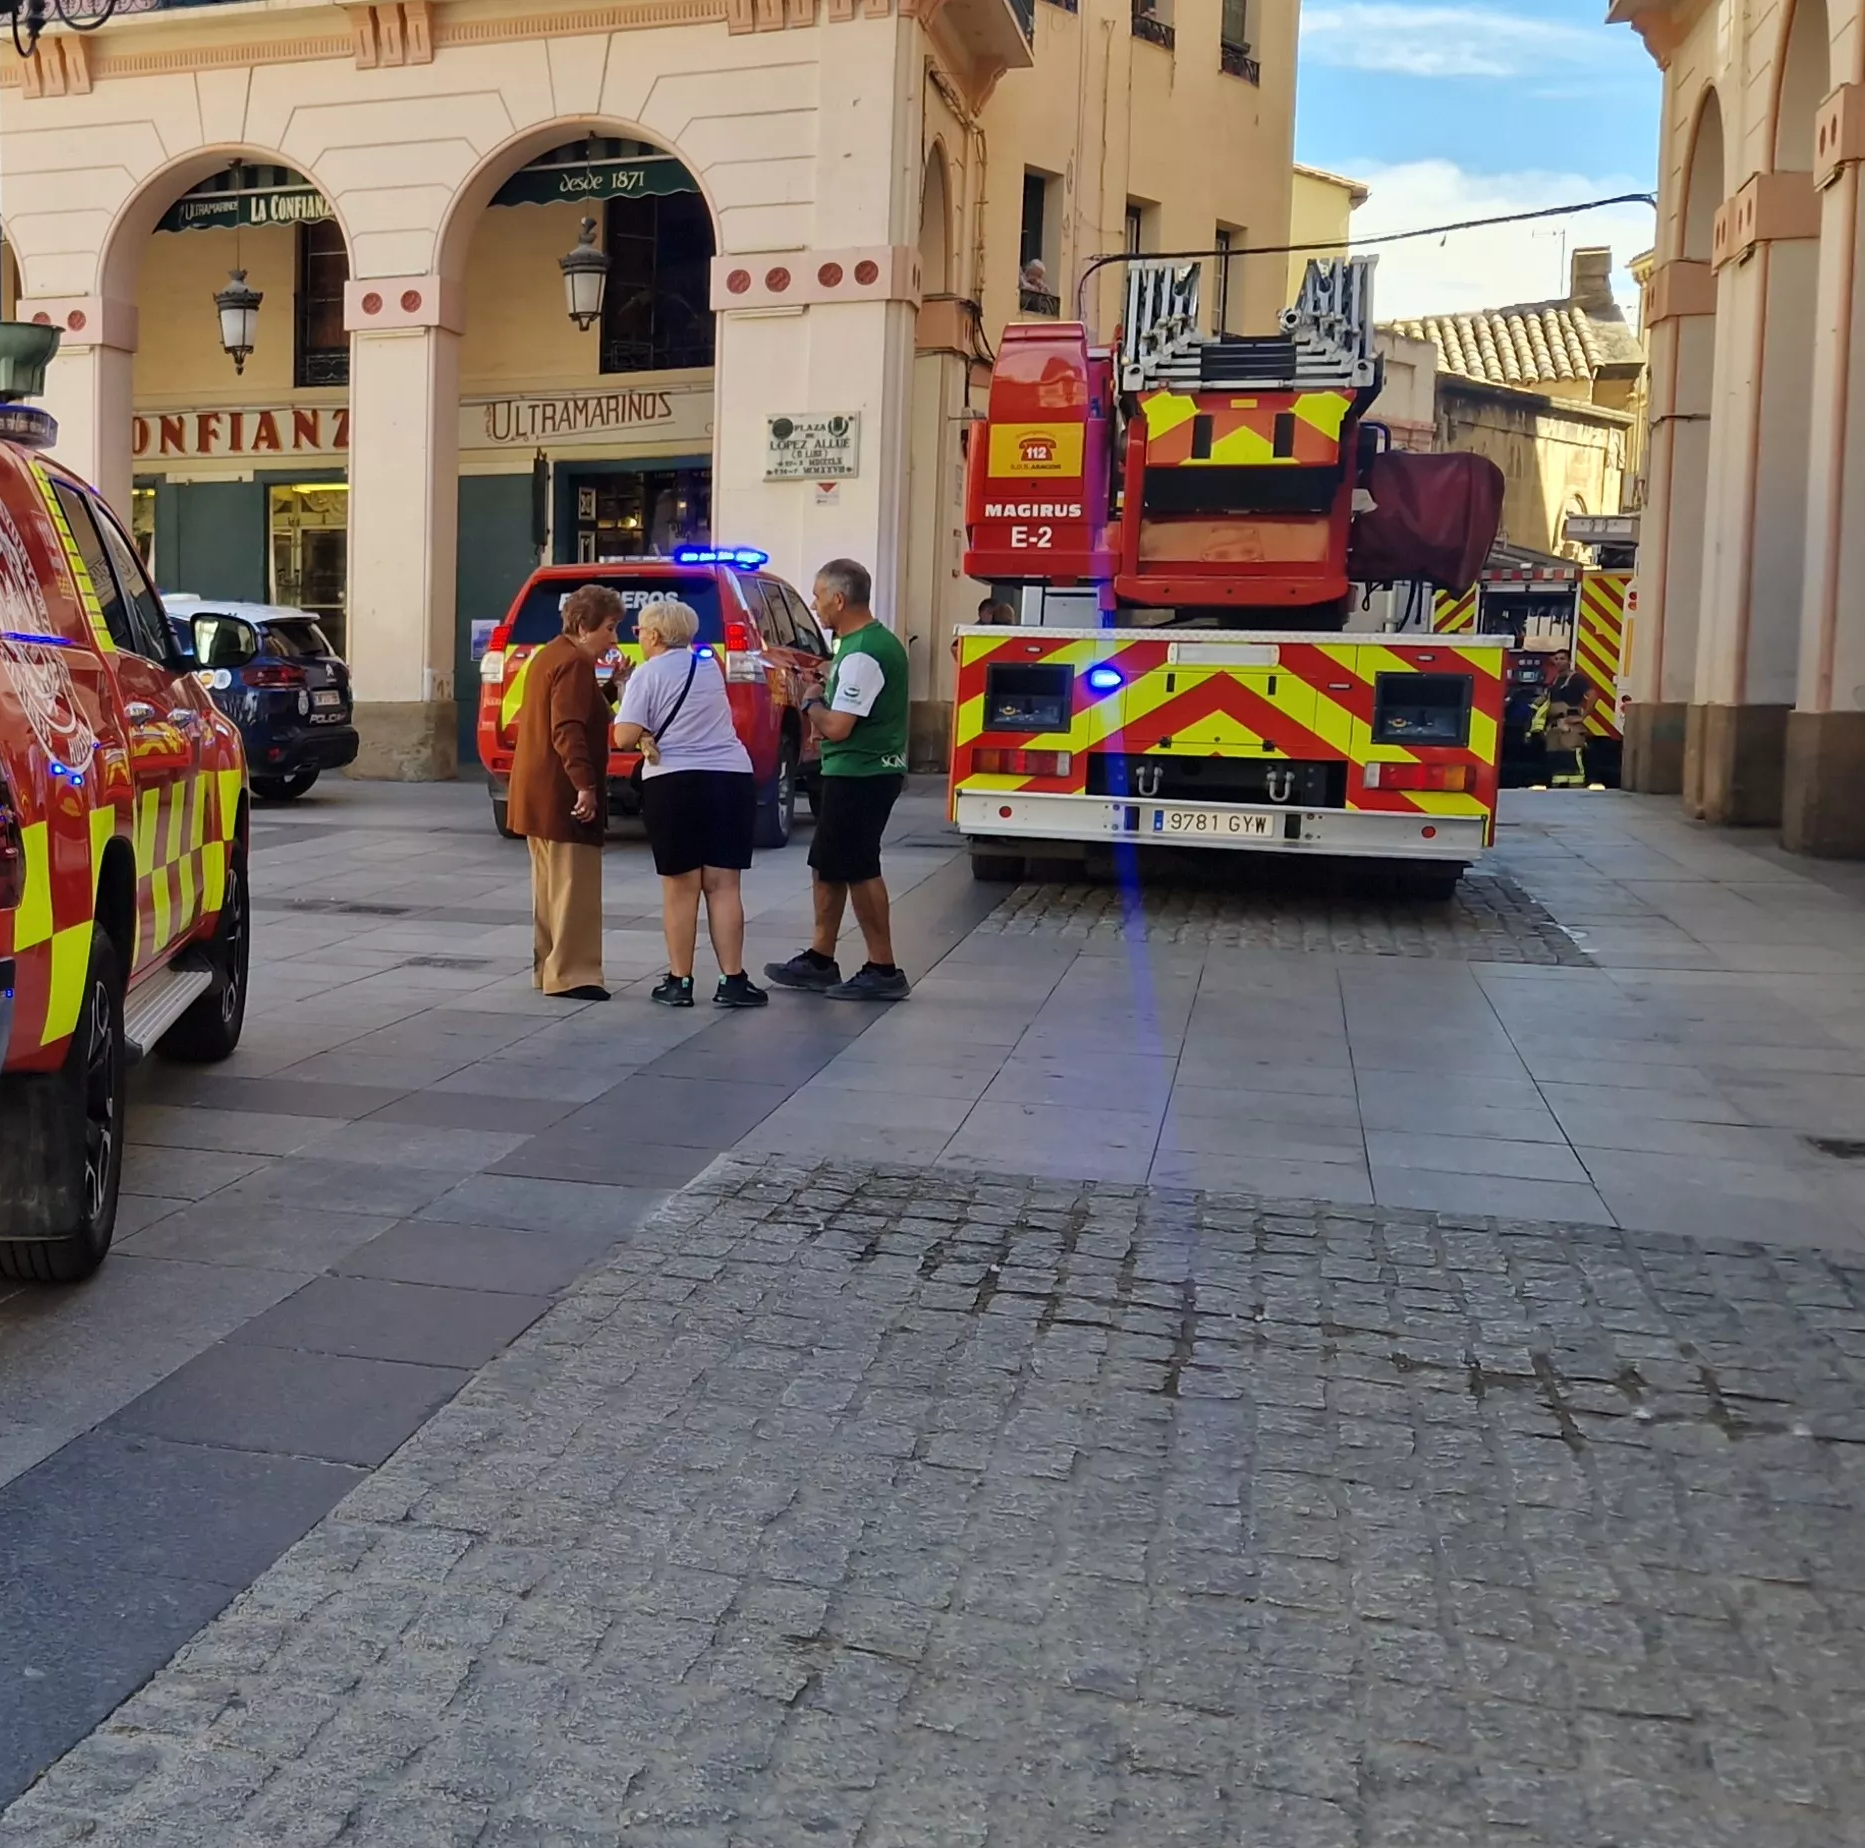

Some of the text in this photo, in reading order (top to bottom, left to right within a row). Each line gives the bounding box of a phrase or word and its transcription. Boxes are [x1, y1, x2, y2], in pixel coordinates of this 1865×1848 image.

[559, 171, 644, 192] desde 1871
[250, 196, 266, 222] LA
[1026, 447, 1047, 459] 112
[985, 504, 1081, 517] MAGIRUS
[1011, 526, 1052, 548] E-2
[1170, 813, 1266, 833] 9781 GYW
